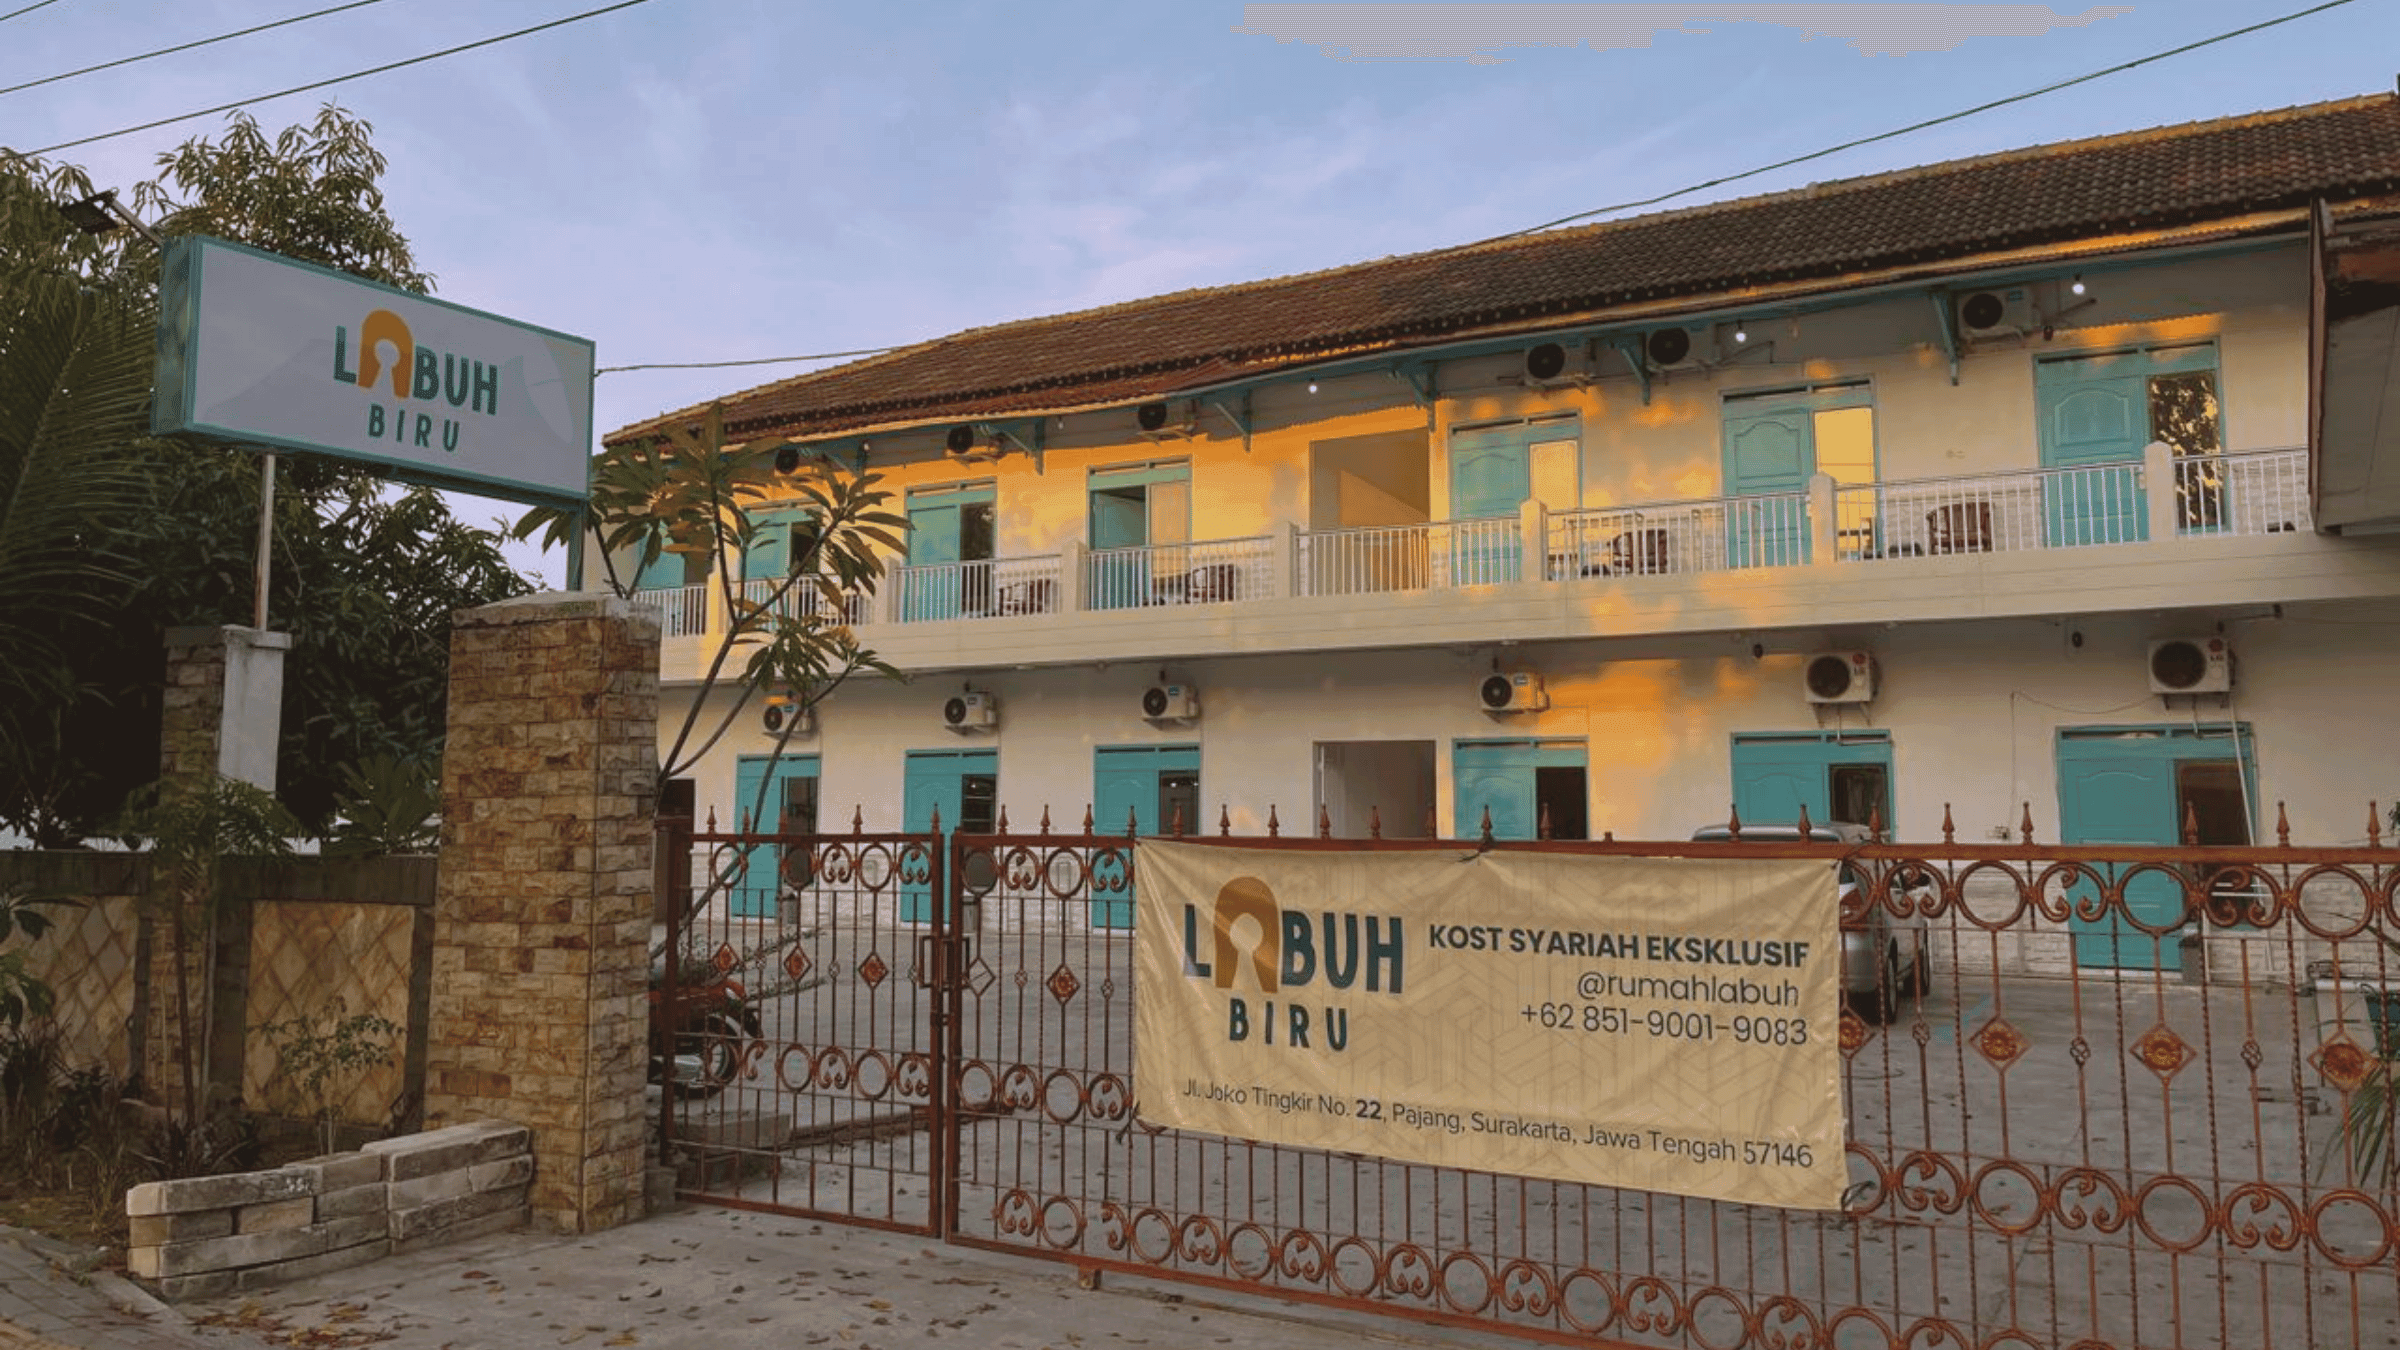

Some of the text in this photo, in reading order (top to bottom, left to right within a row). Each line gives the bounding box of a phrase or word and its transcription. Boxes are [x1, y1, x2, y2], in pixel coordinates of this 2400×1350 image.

[333, 309, 498, 417] LABUH
[368, 403, 460, 452] BIRU
[1183, 876, 1403, 994] LABUH
[1429, 923, 1811, 968] KOST SYARIAH EKSKLUSIF
[1577, 971, 1801, 1008] @rumahlabuh
[1229, 998, 1347, 1051] BIRU
[1520, 1002, 1808, 1047] +62 851-9001-9083
[1183, 1078, 1814, 1168] Jl. Joko Tingkir No. 22, Pajang, Surakarta, Jawa Tengah 57146
